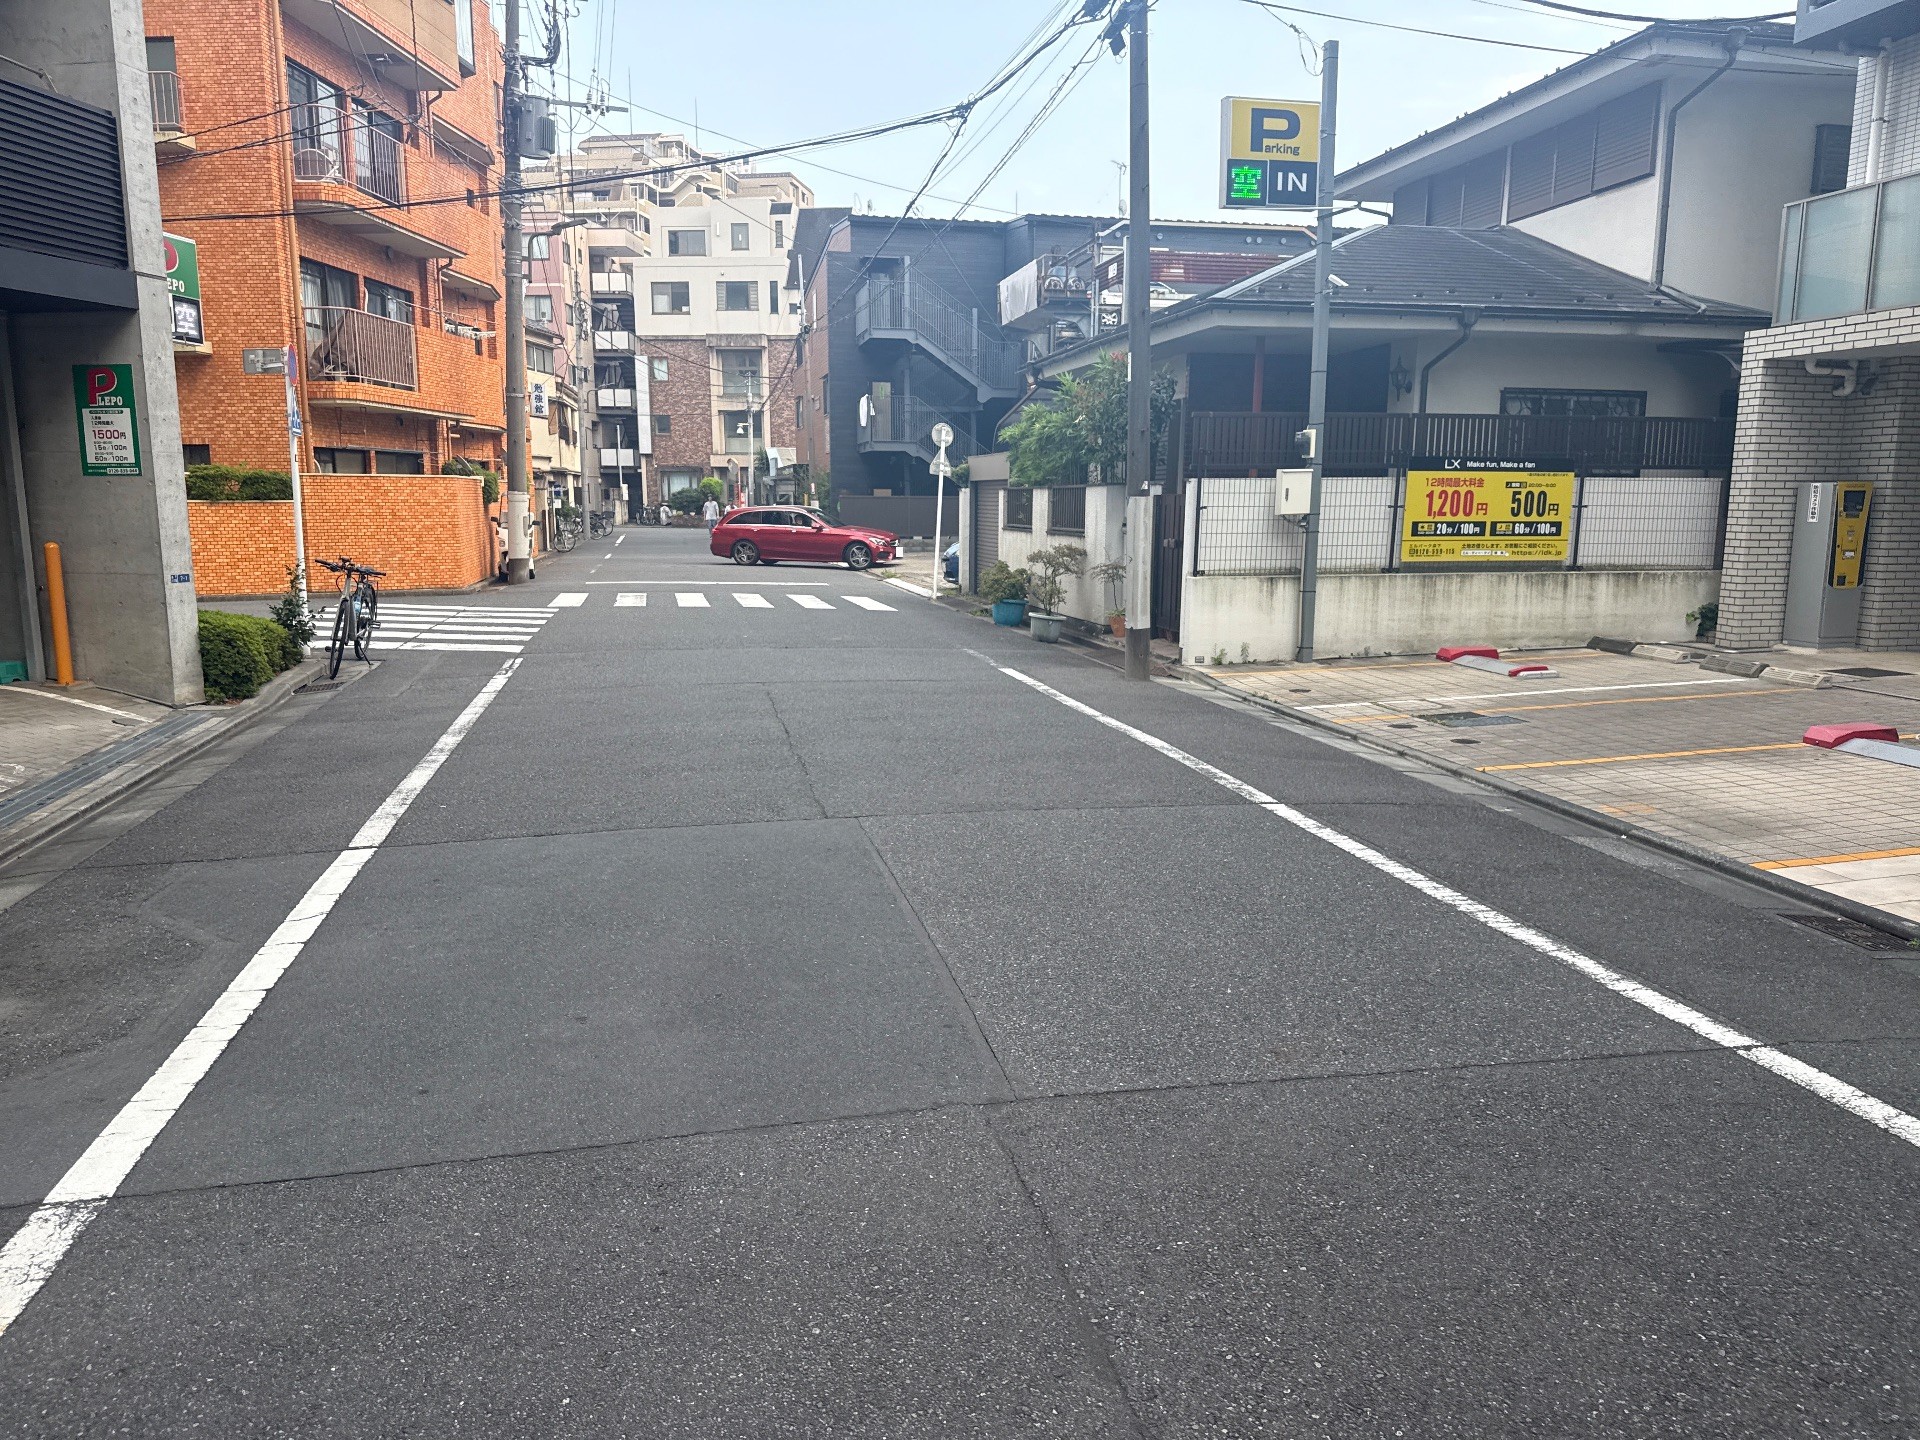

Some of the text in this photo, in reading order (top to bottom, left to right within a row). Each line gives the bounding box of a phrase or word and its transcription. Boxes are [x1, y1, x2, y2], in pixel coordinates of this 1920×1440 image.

[1231, 166, 1262, 198] 空
[1277, 172, 1308, 192] IN
[175, 302, 198, 335] 空
[533, 383, 544, 414] 勉強館
[92, 429, 127, 440] 1500円
[1426, 477, 1485, 488] 12時間最大料金
[1426, 489, 1488, 519] 1,200円
[1510, 490, 1559, 517] 500円
